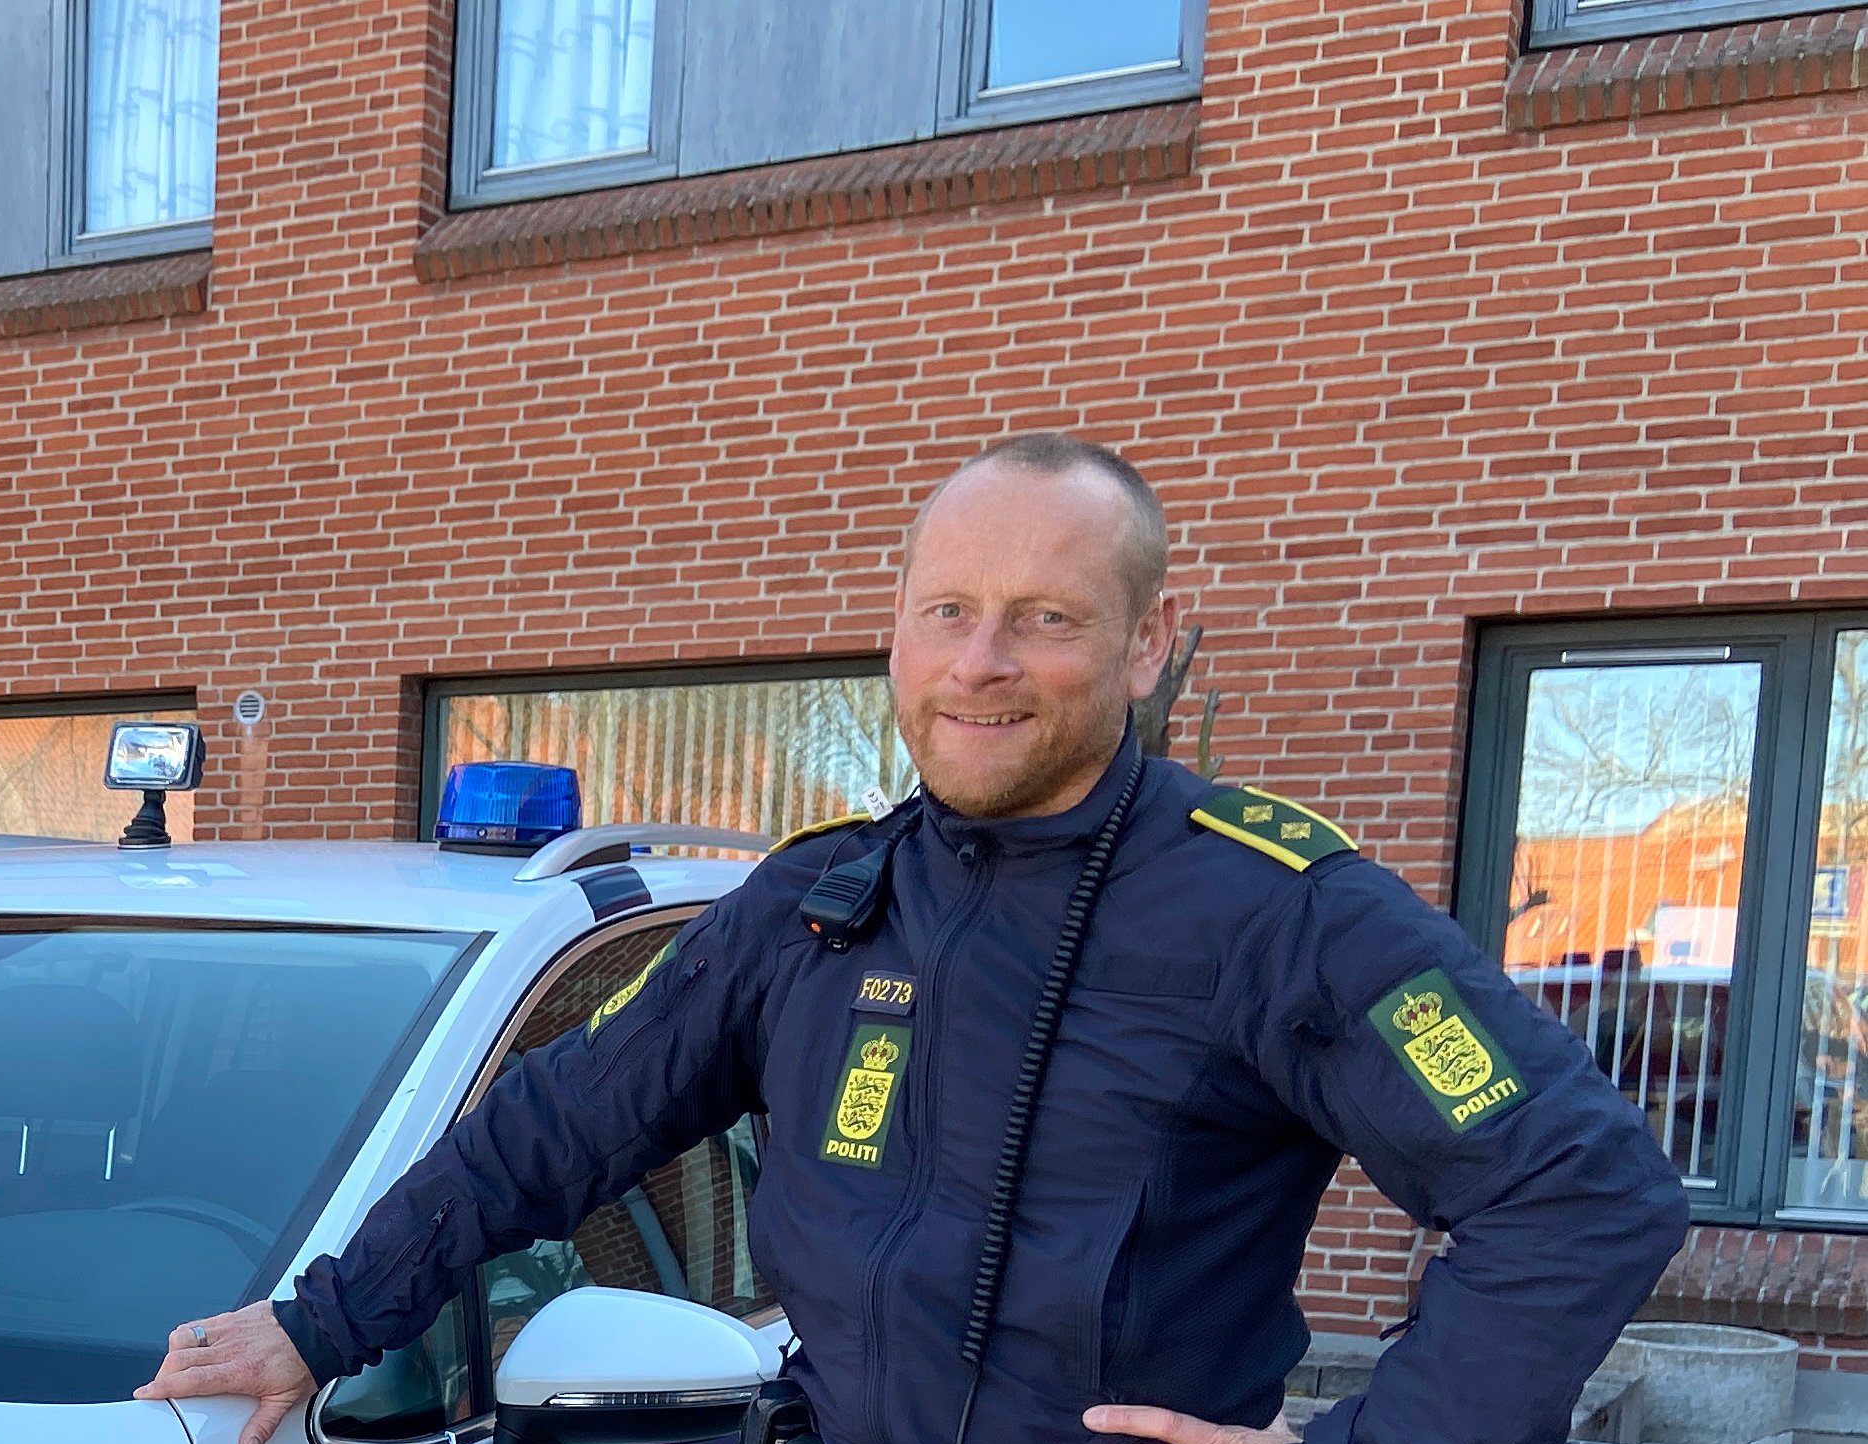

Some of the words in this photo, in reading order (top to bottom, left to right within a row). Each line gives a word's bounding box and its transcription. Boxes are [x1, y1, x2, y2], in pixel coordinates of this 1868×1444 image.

[859, 977, 913, 1004] F0273
[1451, 1078, 1518, 1124] POLITI
[826, 1139, 879, 1162] POLITI
